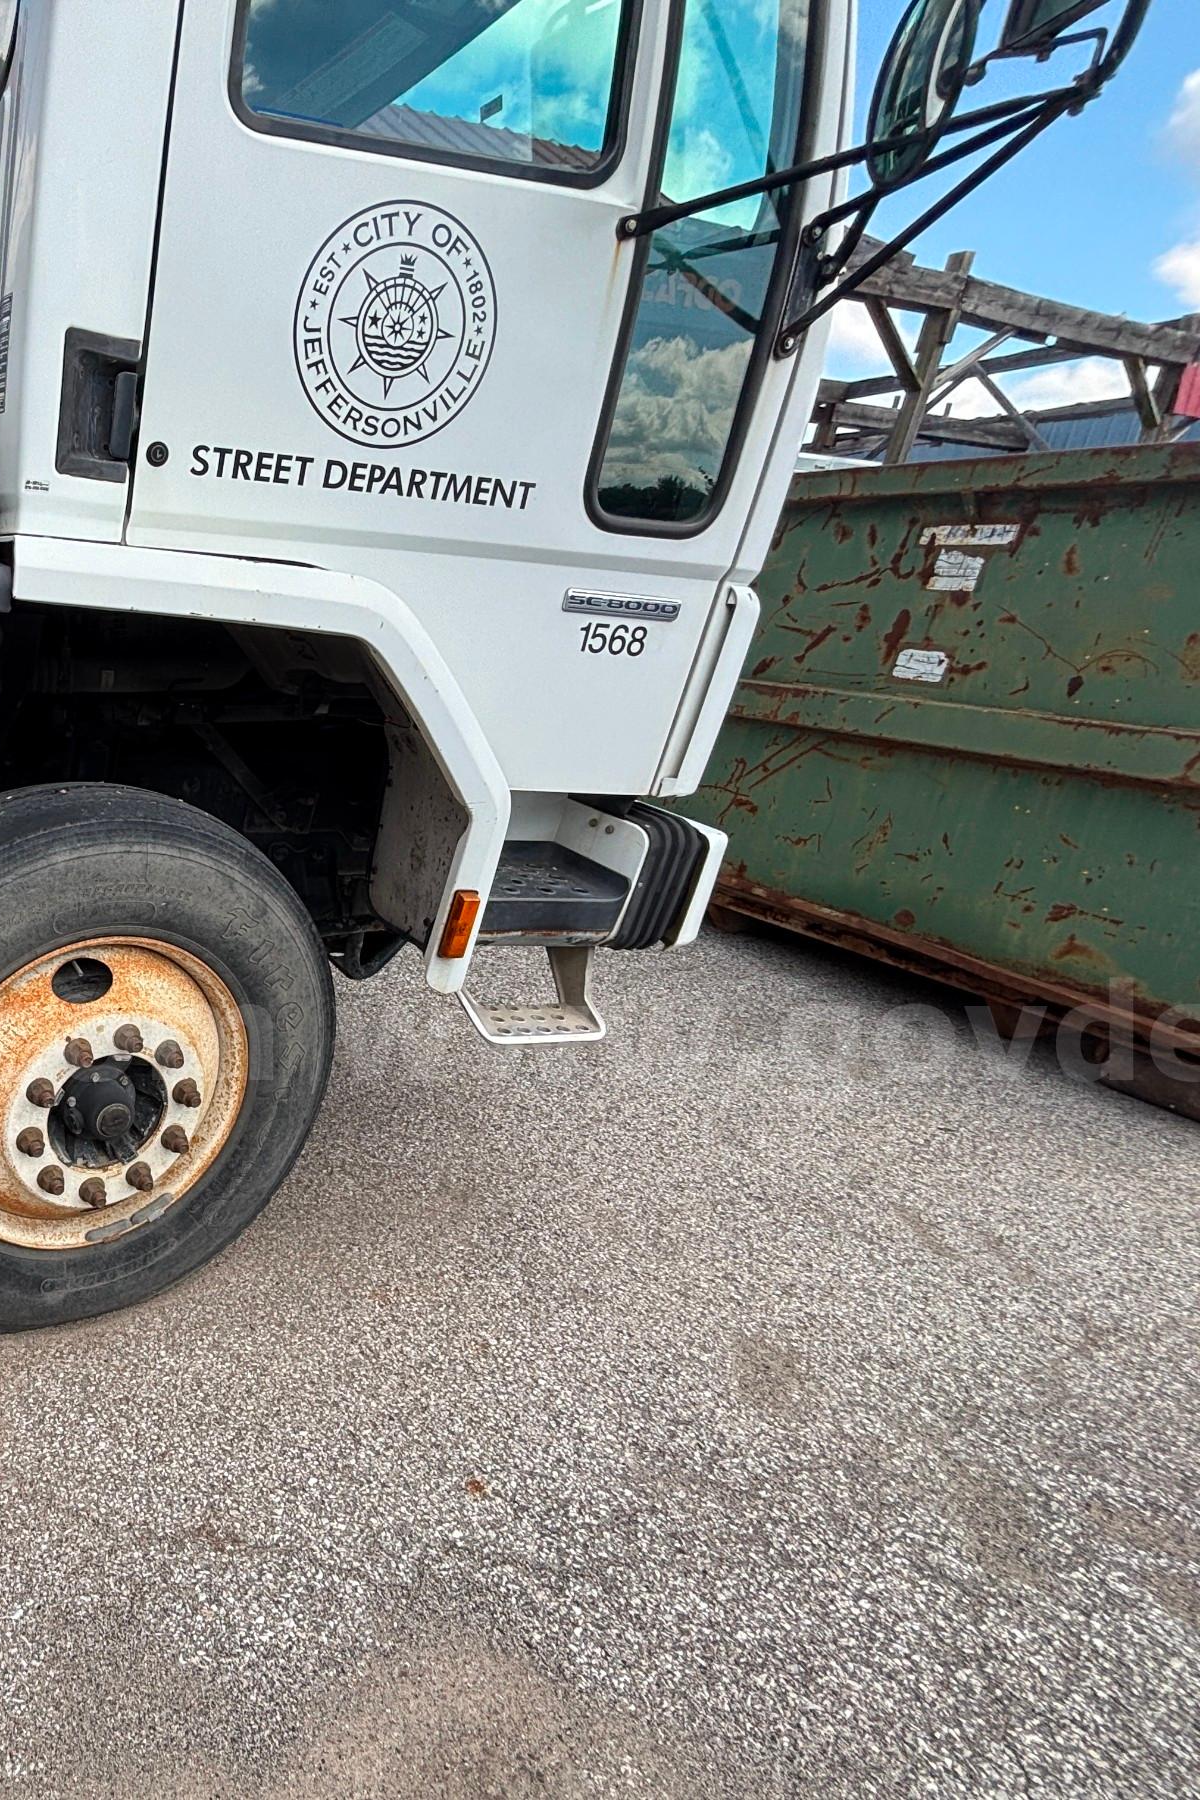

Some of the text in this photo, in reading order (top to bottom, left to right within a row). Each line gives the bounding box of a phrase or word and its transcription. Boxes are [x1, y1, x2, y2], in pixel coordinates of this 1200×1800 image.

[352, 210, 471, 257] CITY OF
[312, 251, 343, 297] EST
[464, 269, 487, 325] 1802
[303, 314, 486, 439] JEFFERSONVILLE
[189, 444, 537, 510] STREET DEPARTMENT
[580, 622, 648, 657] 1568
